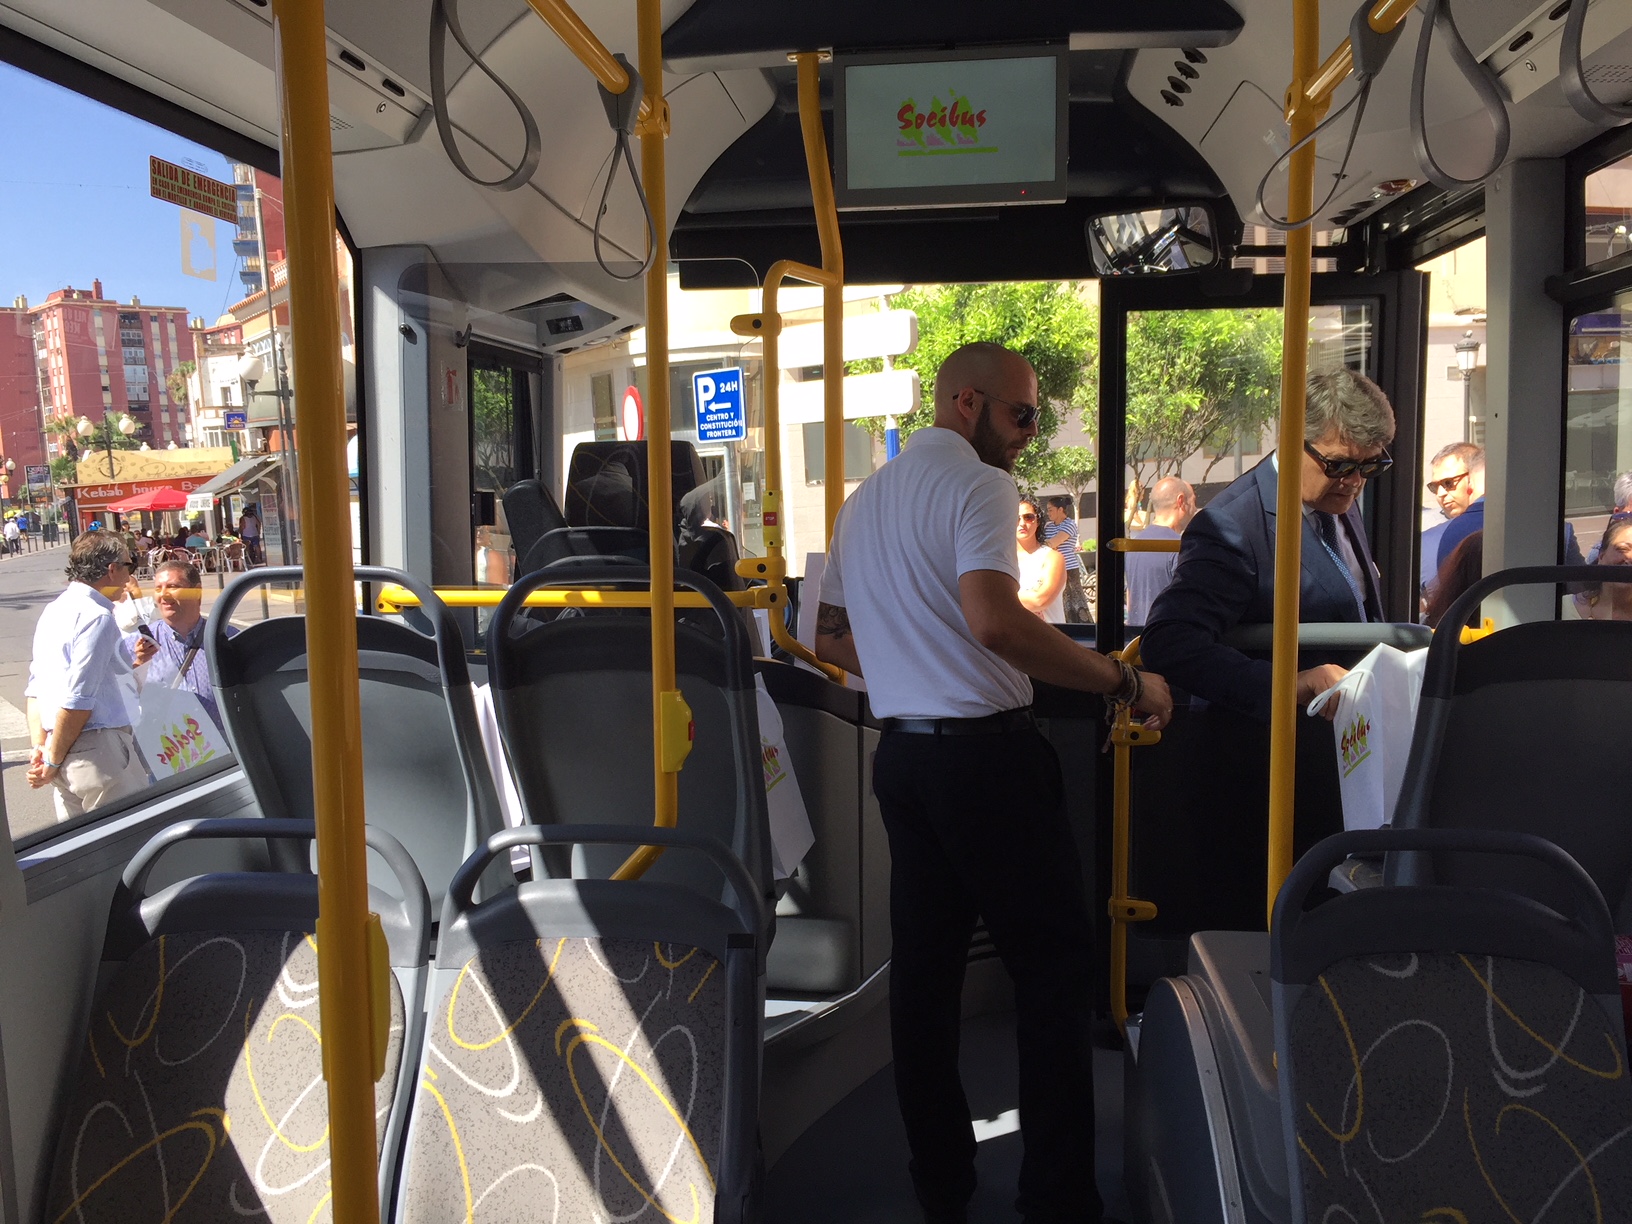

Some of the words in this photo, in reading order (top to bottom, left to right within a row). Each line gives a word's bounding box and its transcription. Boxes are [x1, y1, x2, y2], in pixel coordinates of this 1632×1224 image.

[897, 101, 987, 130] Socibus
[151, 159, 179, 183] SALIDA
[181, 170, 191, 187] DE
[193, 174, 236, 203] EMERGENCIA
[697, 377, 716, 413] P
[720, 381, 738, 393] 24H
[706, 412, 729, 421] CENTRO
[707, 429, 736, 438] FRONTERA
[77, 483, 124, 499] Kebab
[181, 481, 204, 491] Ba
[1341, 719, 1371, 757] Socibus
